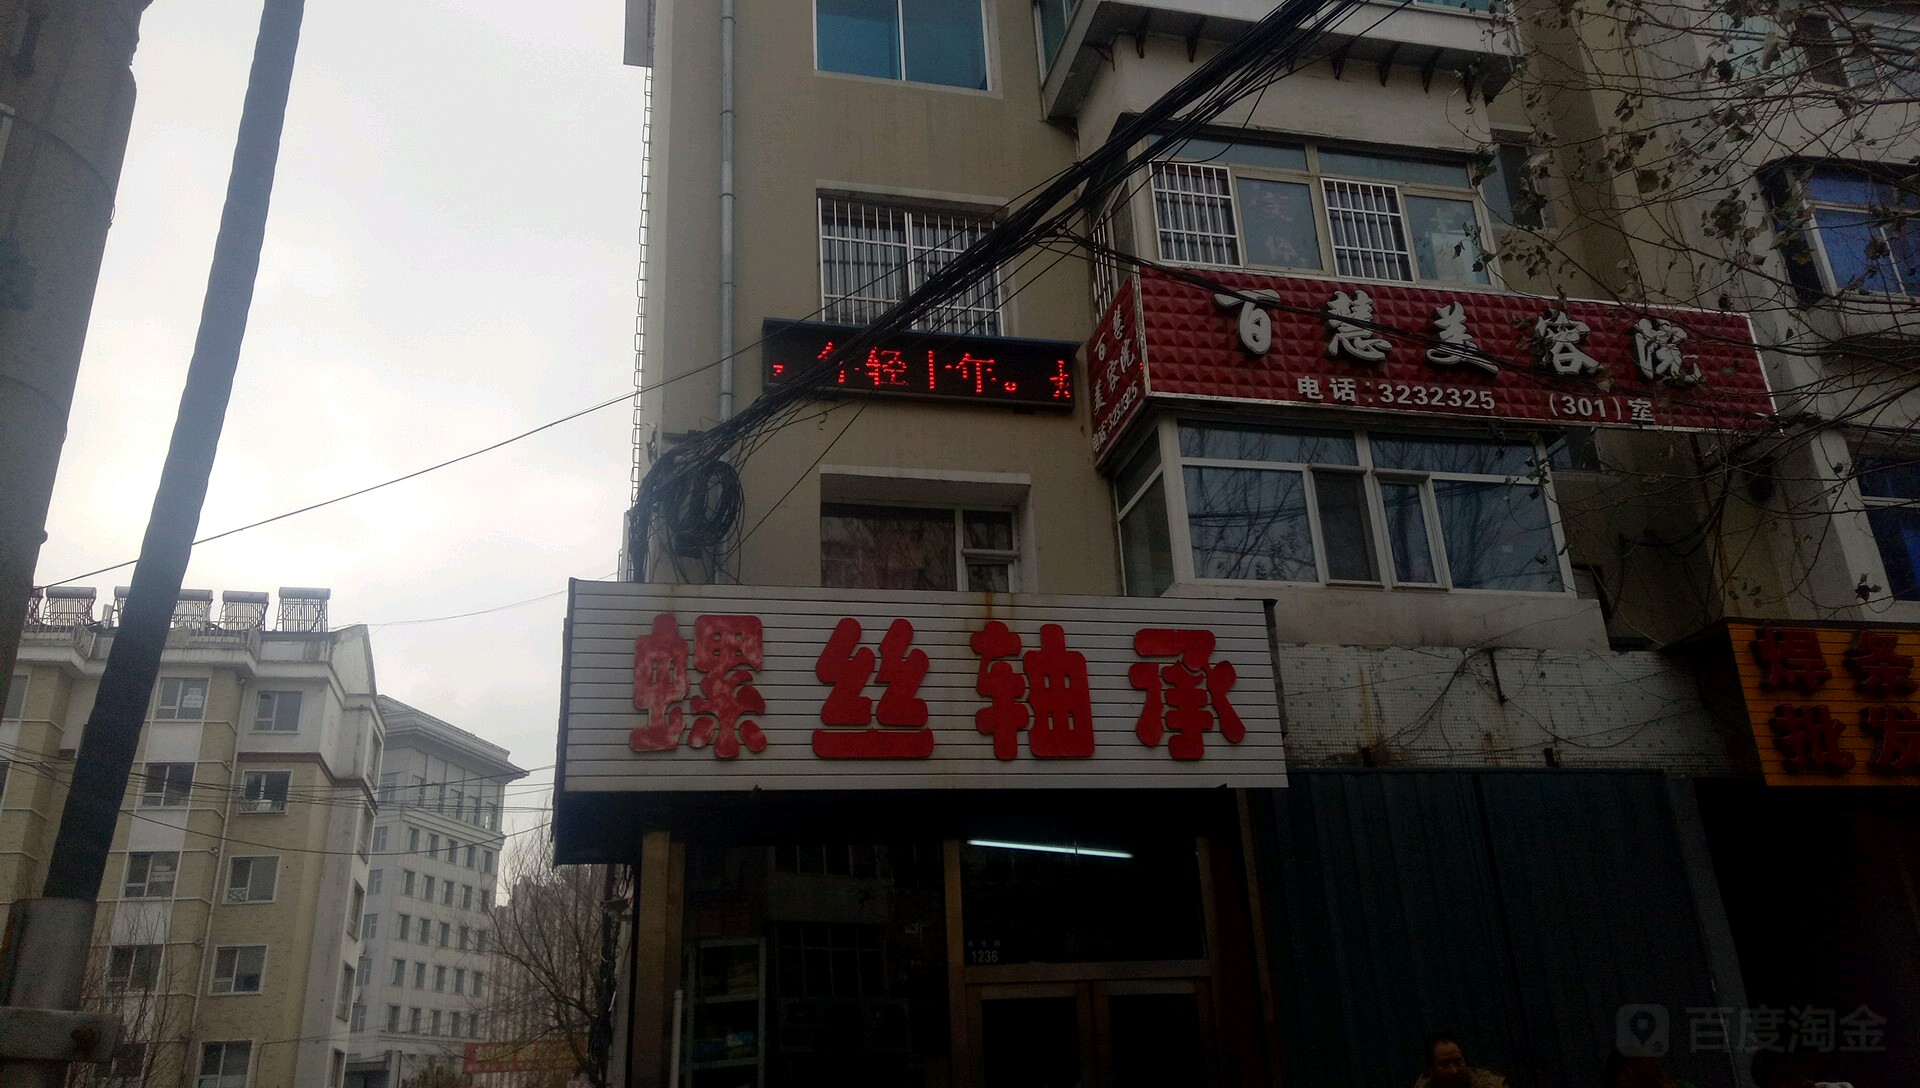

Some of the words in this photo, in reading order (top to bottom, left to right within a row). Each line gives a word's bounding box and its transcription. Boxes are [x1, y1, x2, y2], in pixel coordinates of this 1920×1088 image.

[1214, 289, 1702, 382] 百慧美容院
[628, 612, 1247, 761] 螺丝轴承
[1768, 703, 1920, 773] 批发
[971, 949, 999, 964] 1236
